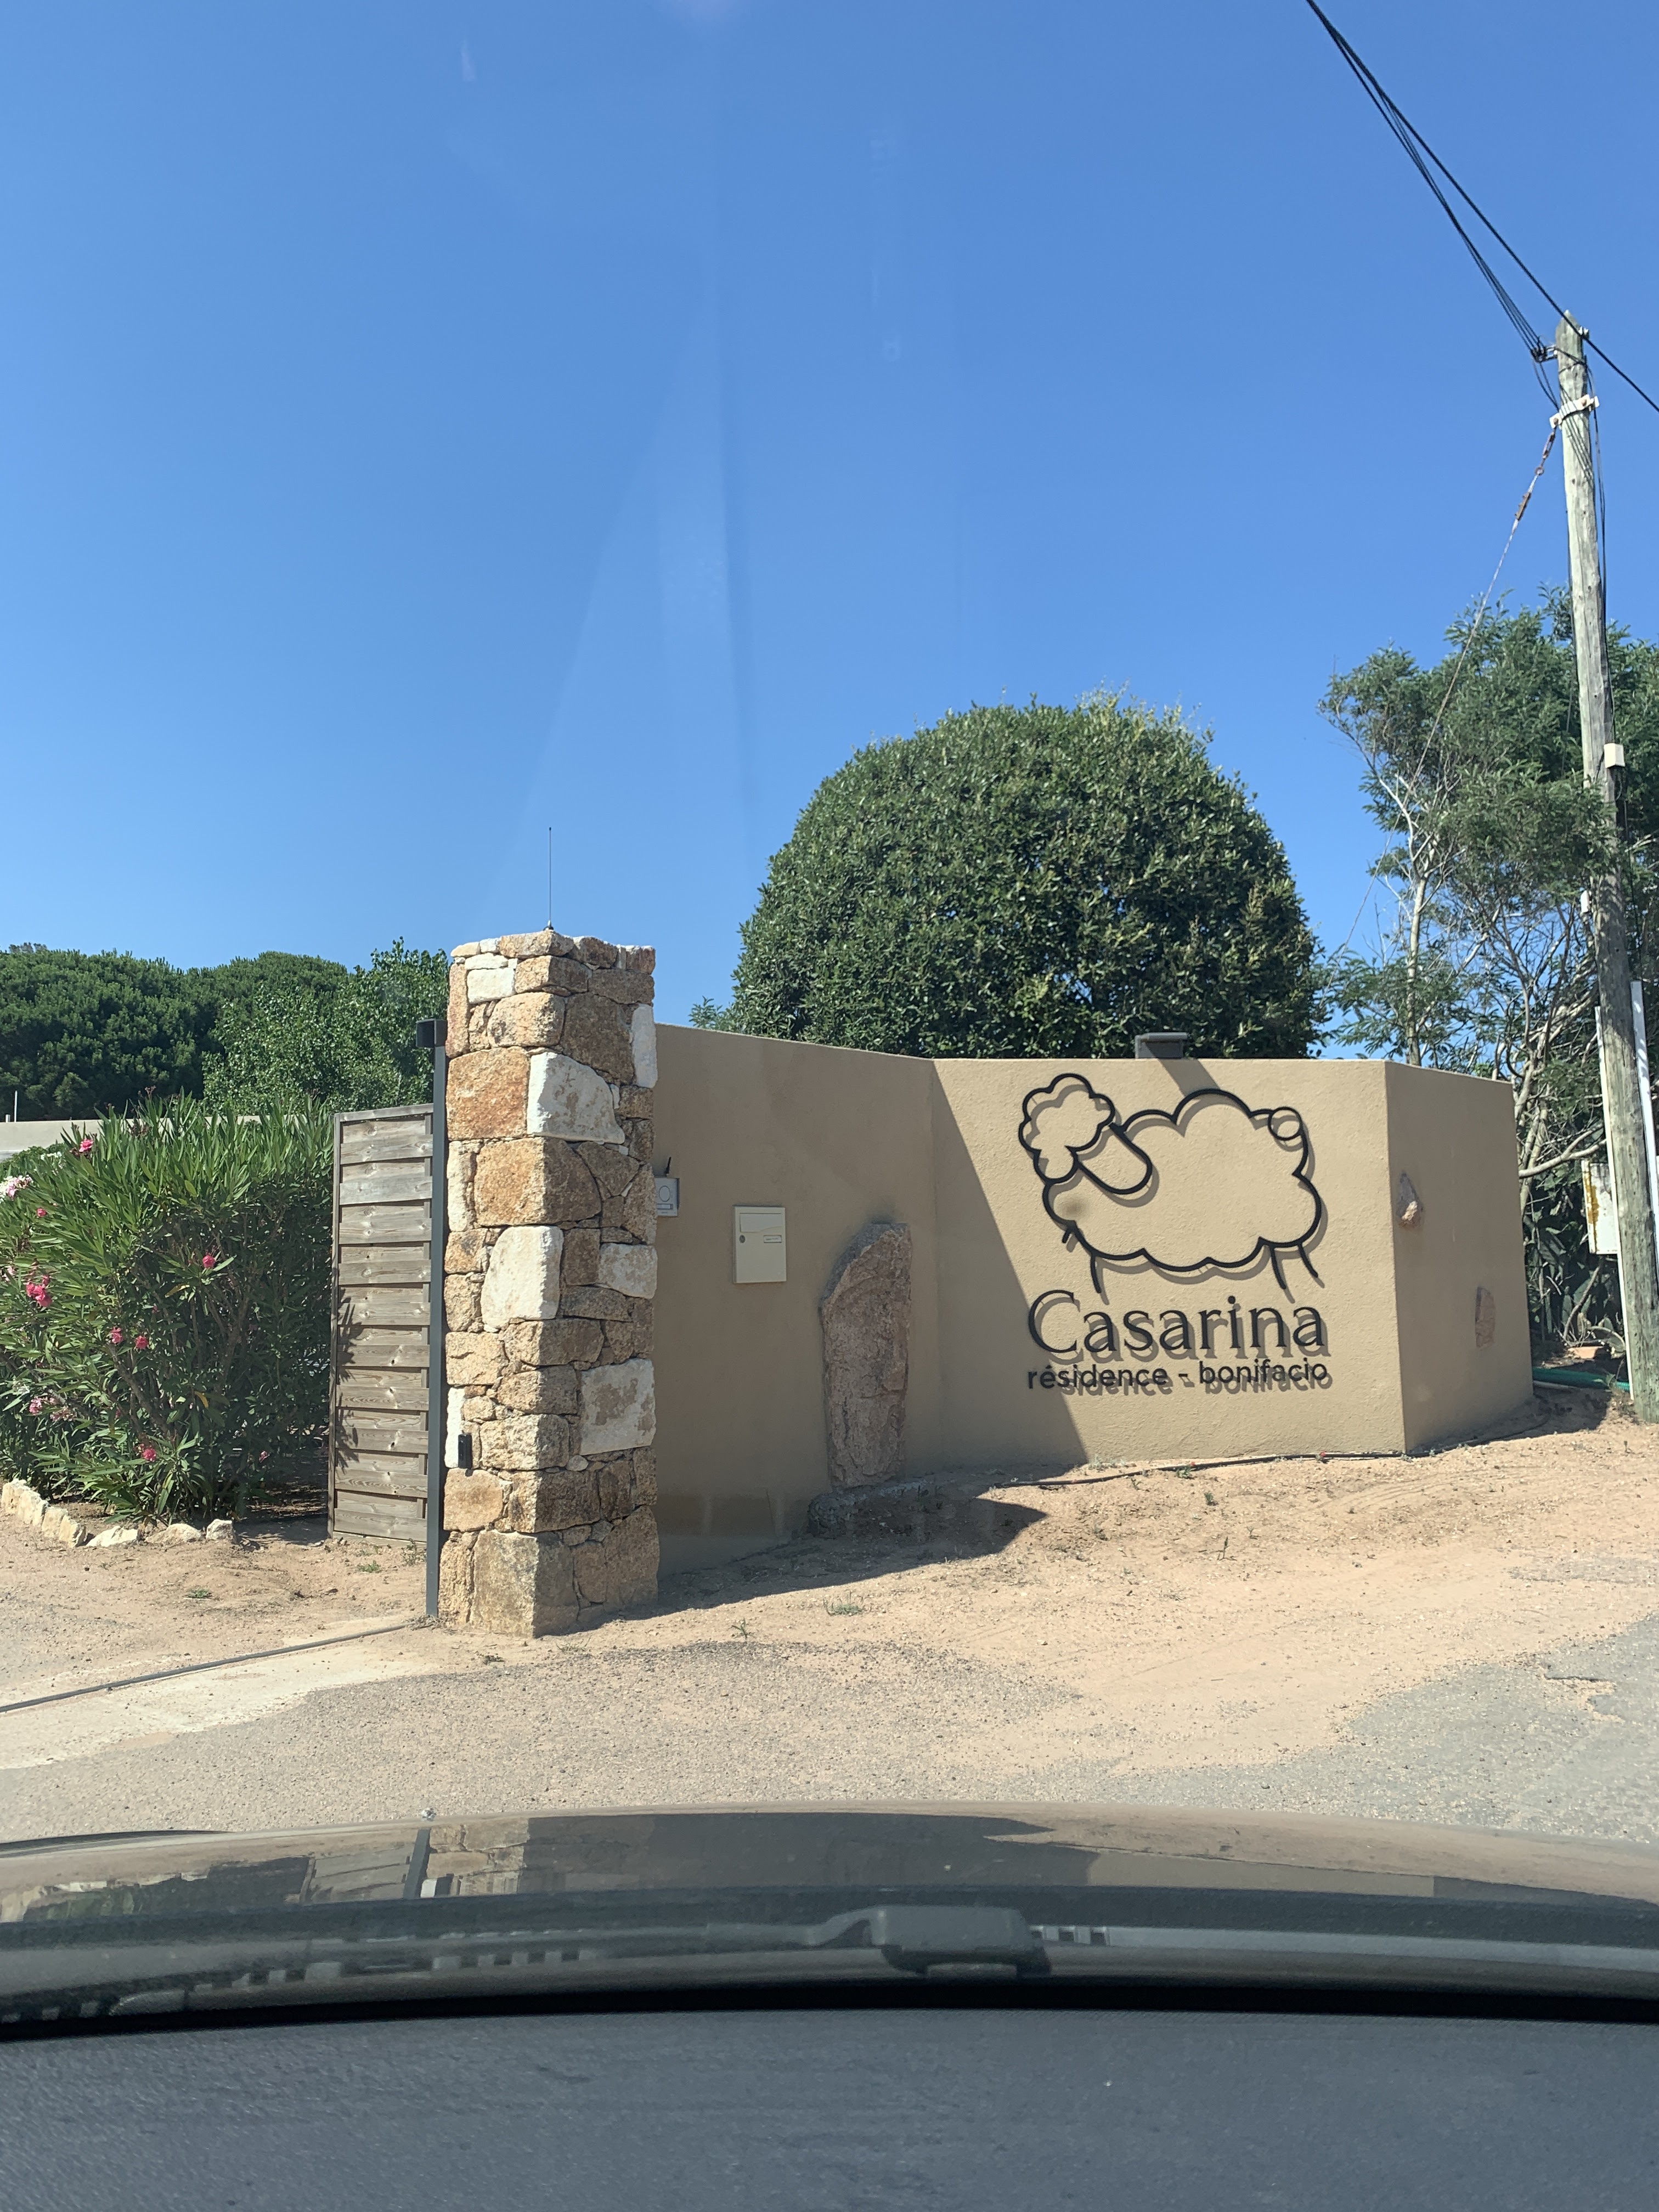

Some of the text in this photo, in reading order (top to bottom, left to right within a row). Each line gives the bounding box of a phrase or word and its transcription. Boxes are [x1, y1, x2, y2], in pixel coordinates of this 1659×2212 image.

[1029, 1290, 1325, 1353] Casarina
[1028, 1364, 1168, 1389] résidence
[1199, 1358, 1328, 1385] bonifacio
